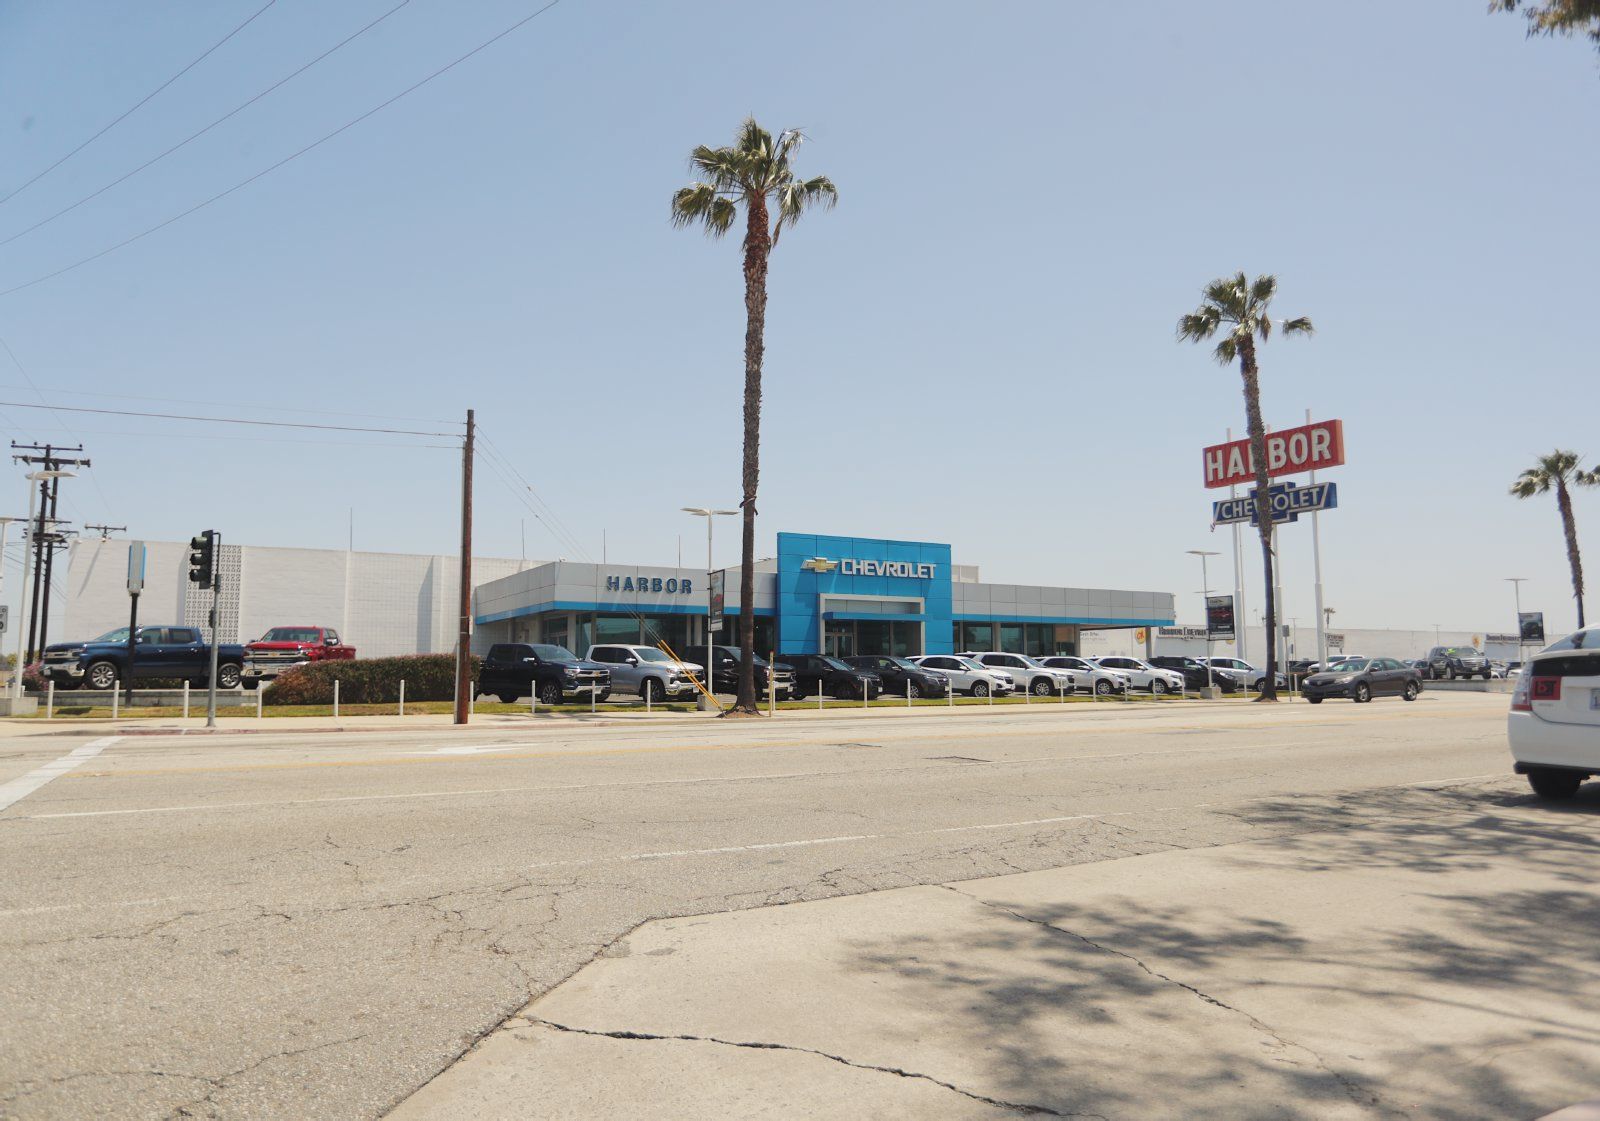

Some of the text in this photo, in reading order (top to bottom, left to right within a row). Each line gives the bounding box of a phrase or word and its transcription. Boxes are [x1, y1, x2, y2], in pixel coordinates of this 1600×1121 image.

[1221, 488, 1320, 519] CHEOLET
[841, 558, 937, 579] CHEVROLET
[606, 576, 692, 594] HARBOR
